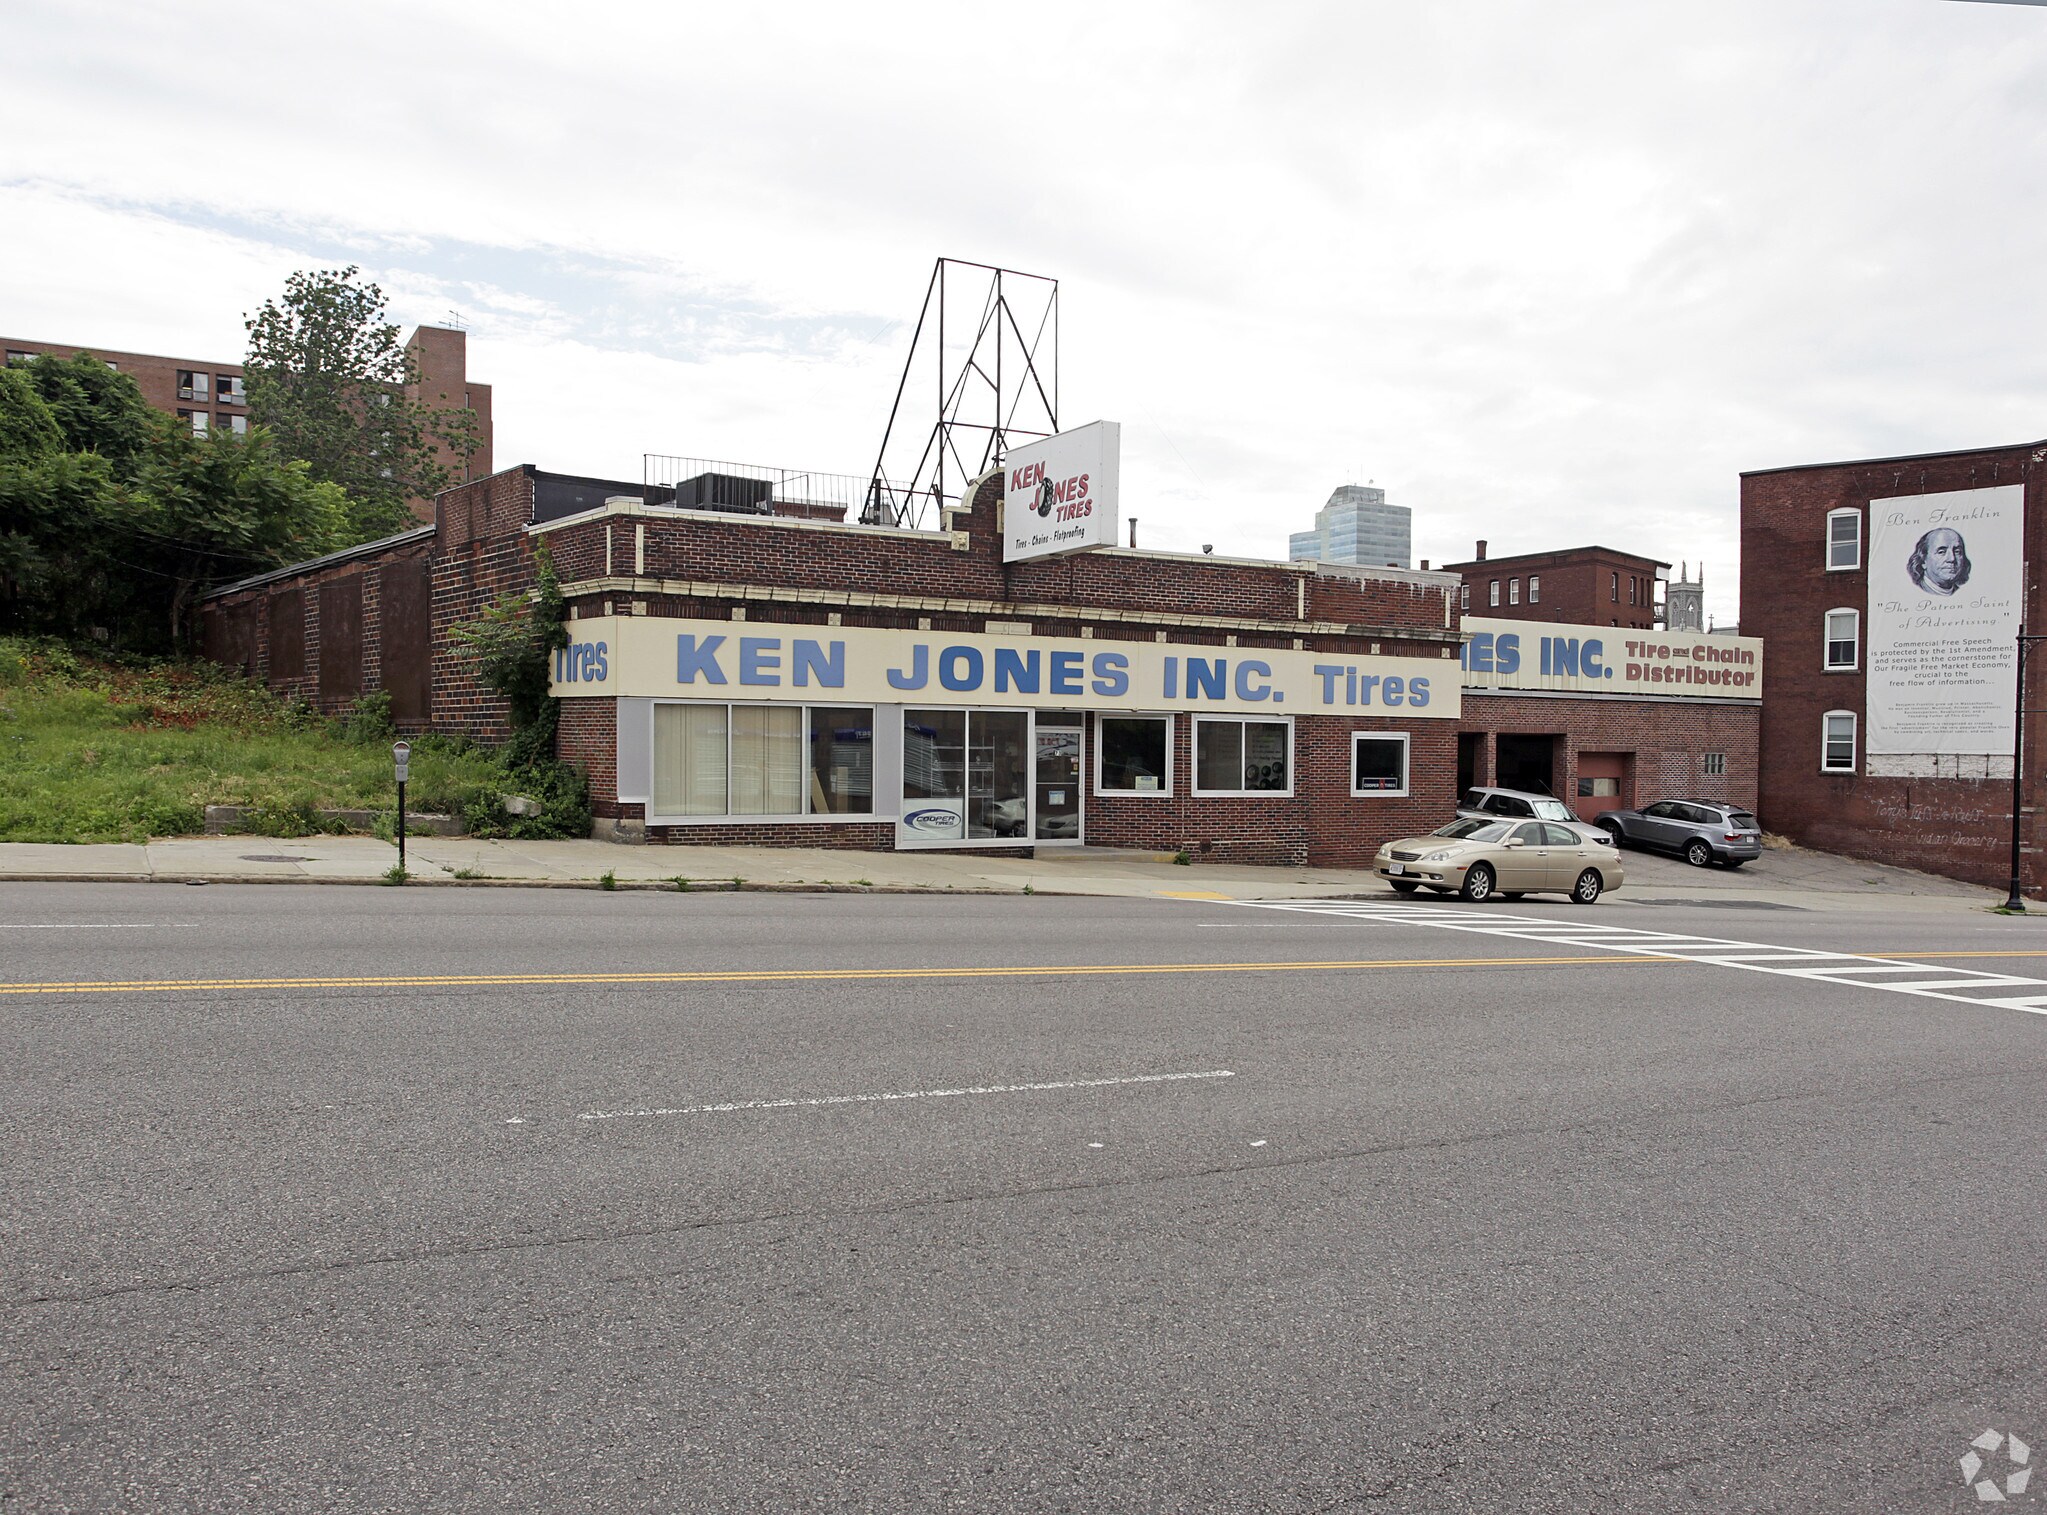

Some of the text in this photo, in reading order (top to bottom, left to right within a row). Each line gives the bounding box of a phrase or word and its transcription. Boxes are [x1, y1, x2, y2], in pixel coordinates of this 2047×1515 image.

[1011, 461, 1045, 491] KEN
[1056, 499, 1092, 522] TIRES
[1886, 507, 2000, 526] Ben Franklin
[1016, 539, 1026, 549] Tires
[1032, 534, 1048, 546] Chains
[1054, 526, 1084, 542] Flatproofing
[1916, 600, 1963, 612] Patron
[1970, 596, 2010, 608] Saint
[1898, 617, 1912, 630] of
[1540, 636, 1613, 678] INC.
[1626, 641, 1670, 659] Tire
[1692, 646, 1754, 664] Chain
[677, 634, 1430, 707] KEN JONES INC. Tires
[1626, 663, 1754, 686] Distributor
